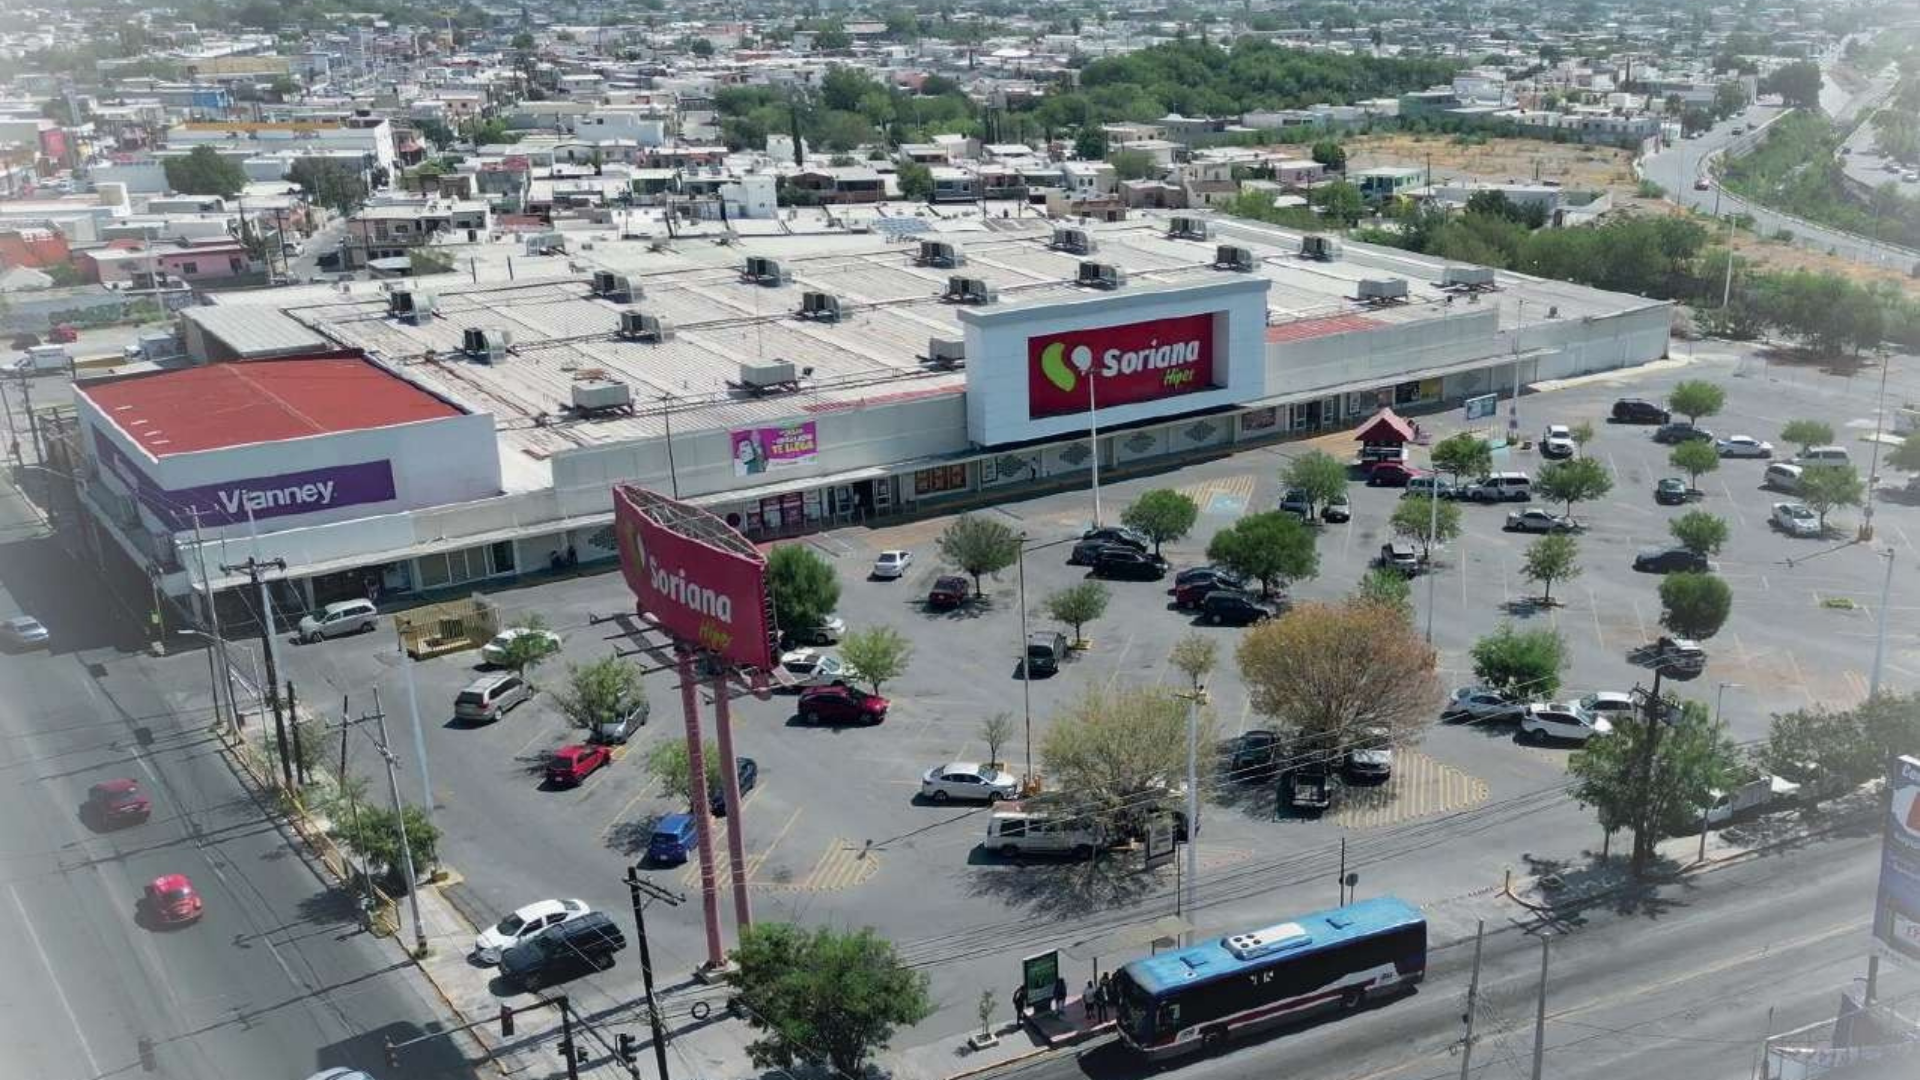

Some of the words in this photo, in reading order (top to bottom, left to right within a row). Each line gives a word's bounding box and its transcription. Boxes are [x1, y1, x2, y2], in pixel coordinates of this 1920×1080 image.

[1101, 338, 1199, 378] Soriana
[1163, 367, 1194, 390] Hiper
[217, 480, 334, 514] Vianney
[649, 554, 732, 624] Soriana
